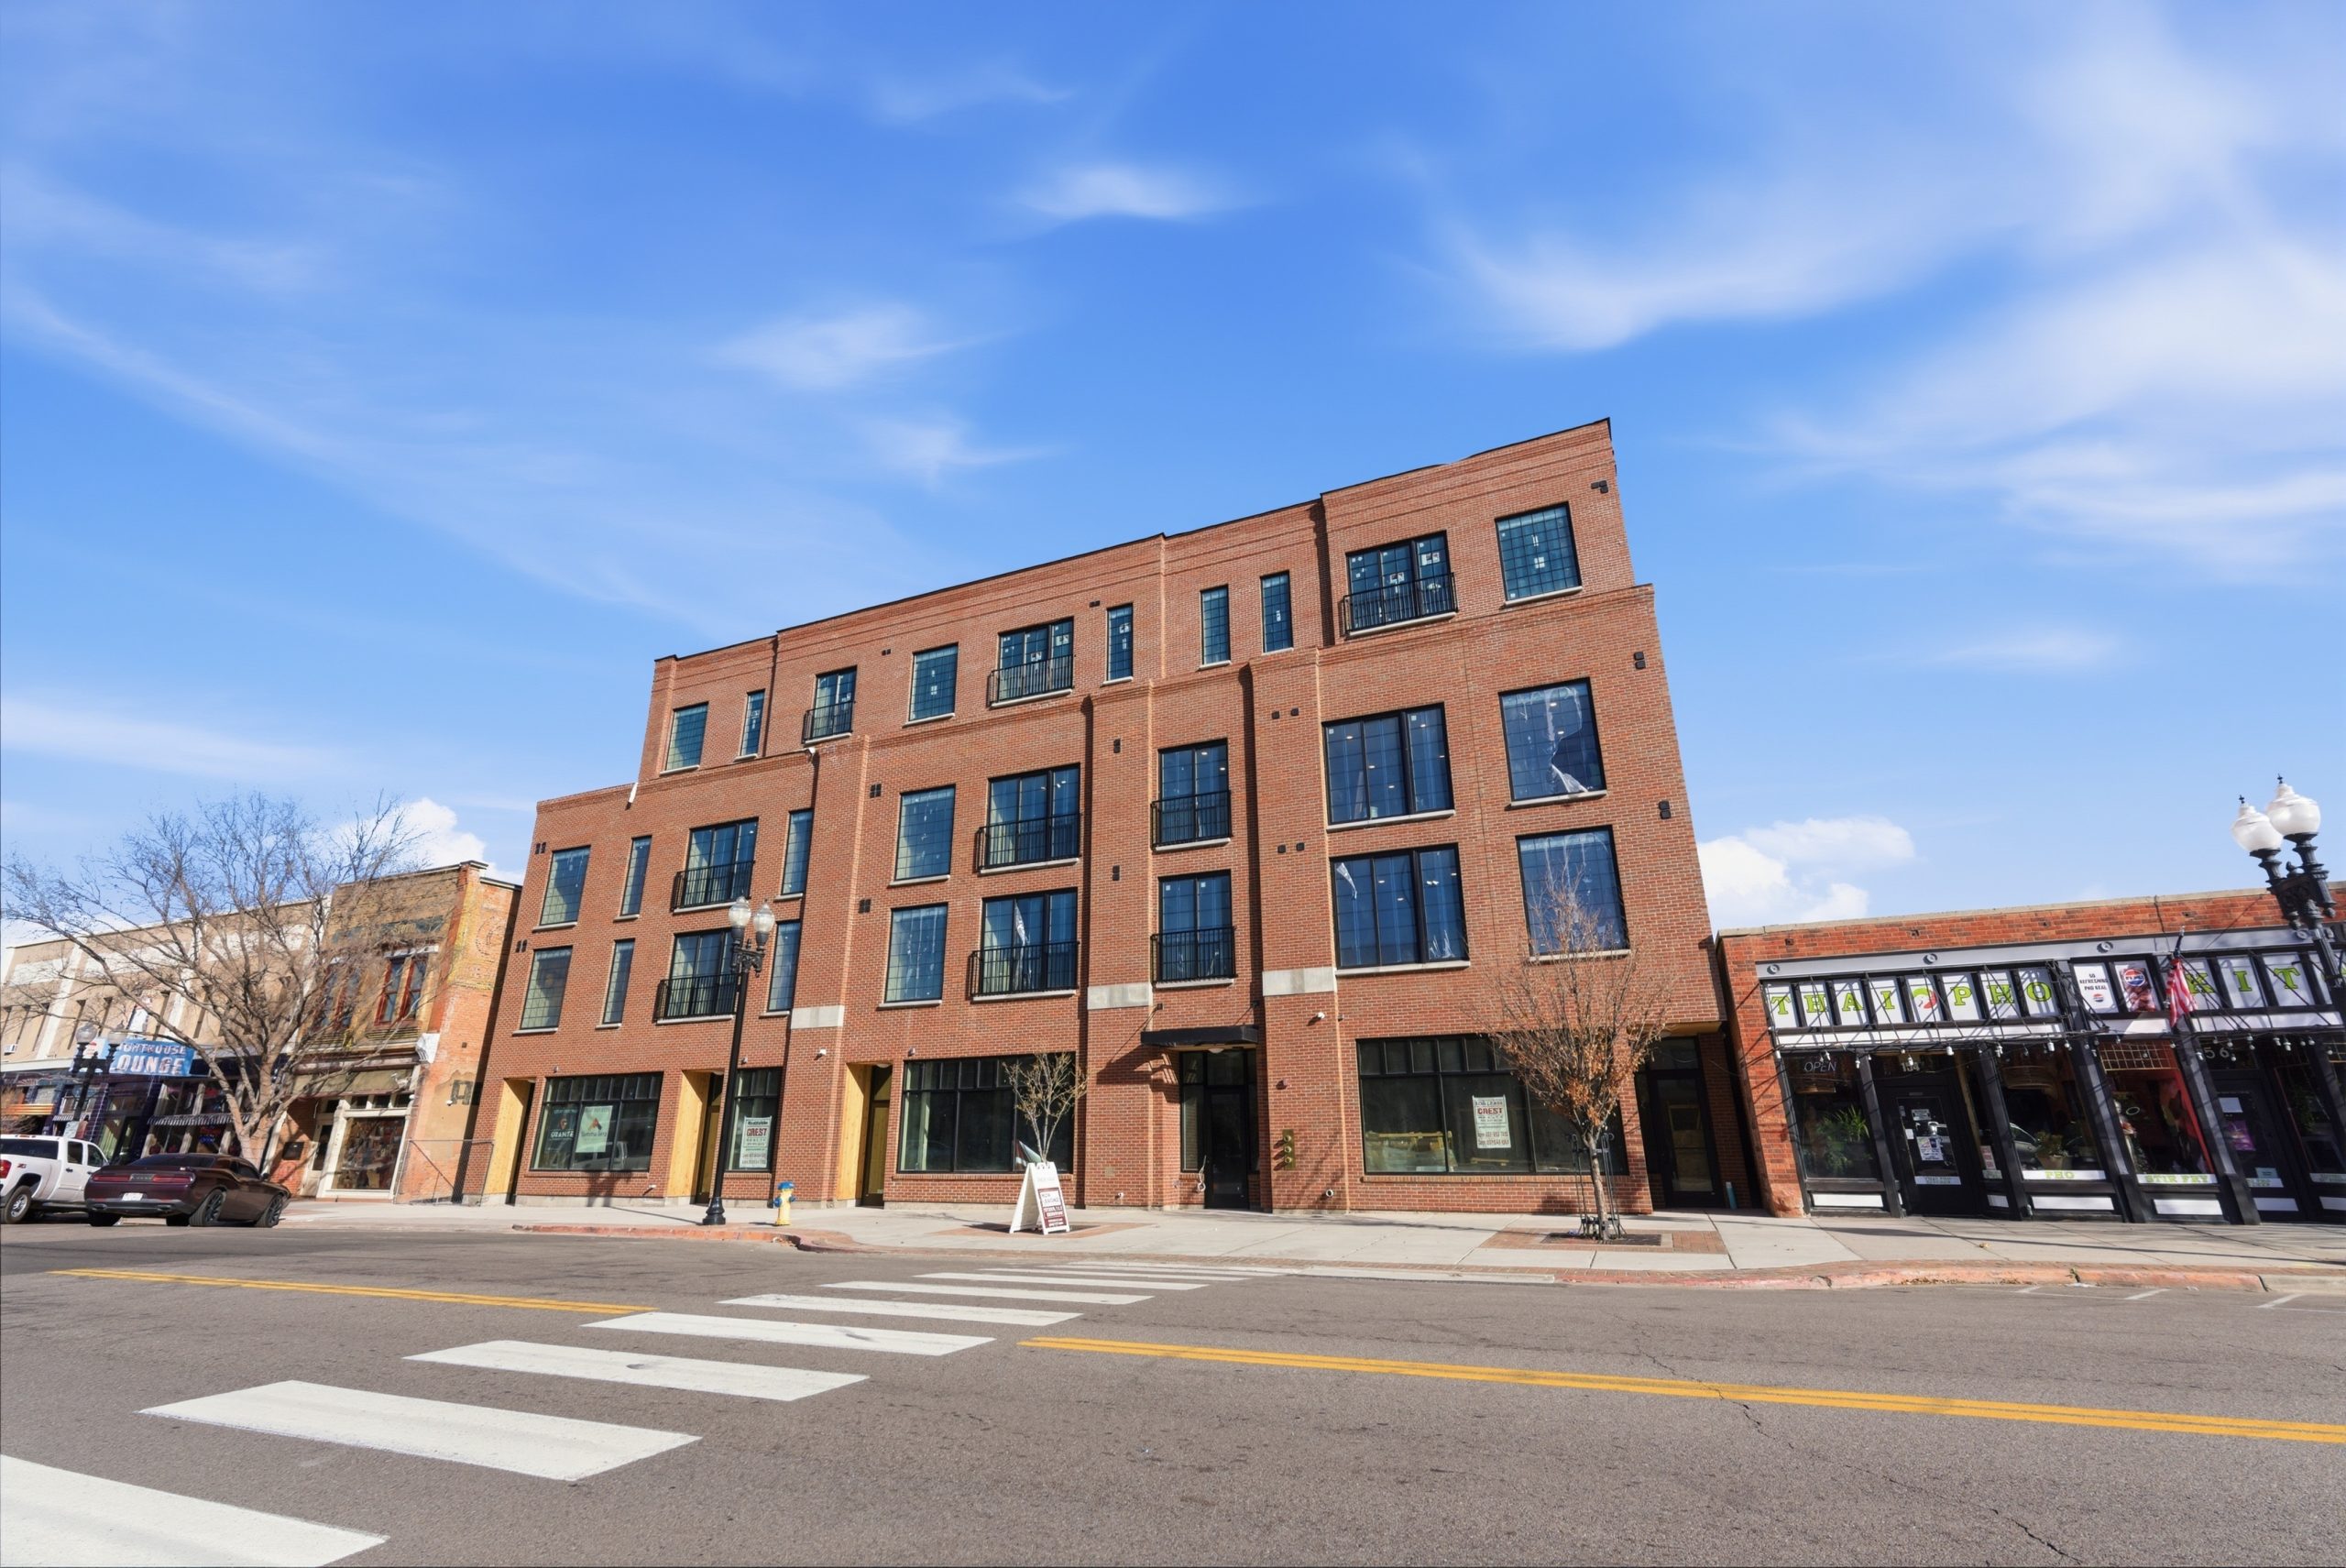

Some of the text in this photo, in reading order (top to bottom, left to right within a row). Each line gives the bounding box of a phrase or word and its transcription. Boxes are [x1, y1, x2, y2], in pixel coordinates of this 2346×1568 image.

[1770, 981, 2053, 1015] THAI PHO
[115, 1054, 185, 1075] OUNGE
[1803, 1061, 1837, 1072] OPEN
[747, 1127, 768, 1136] CREST
[2145, 1175, 2177, 1183] STIR
